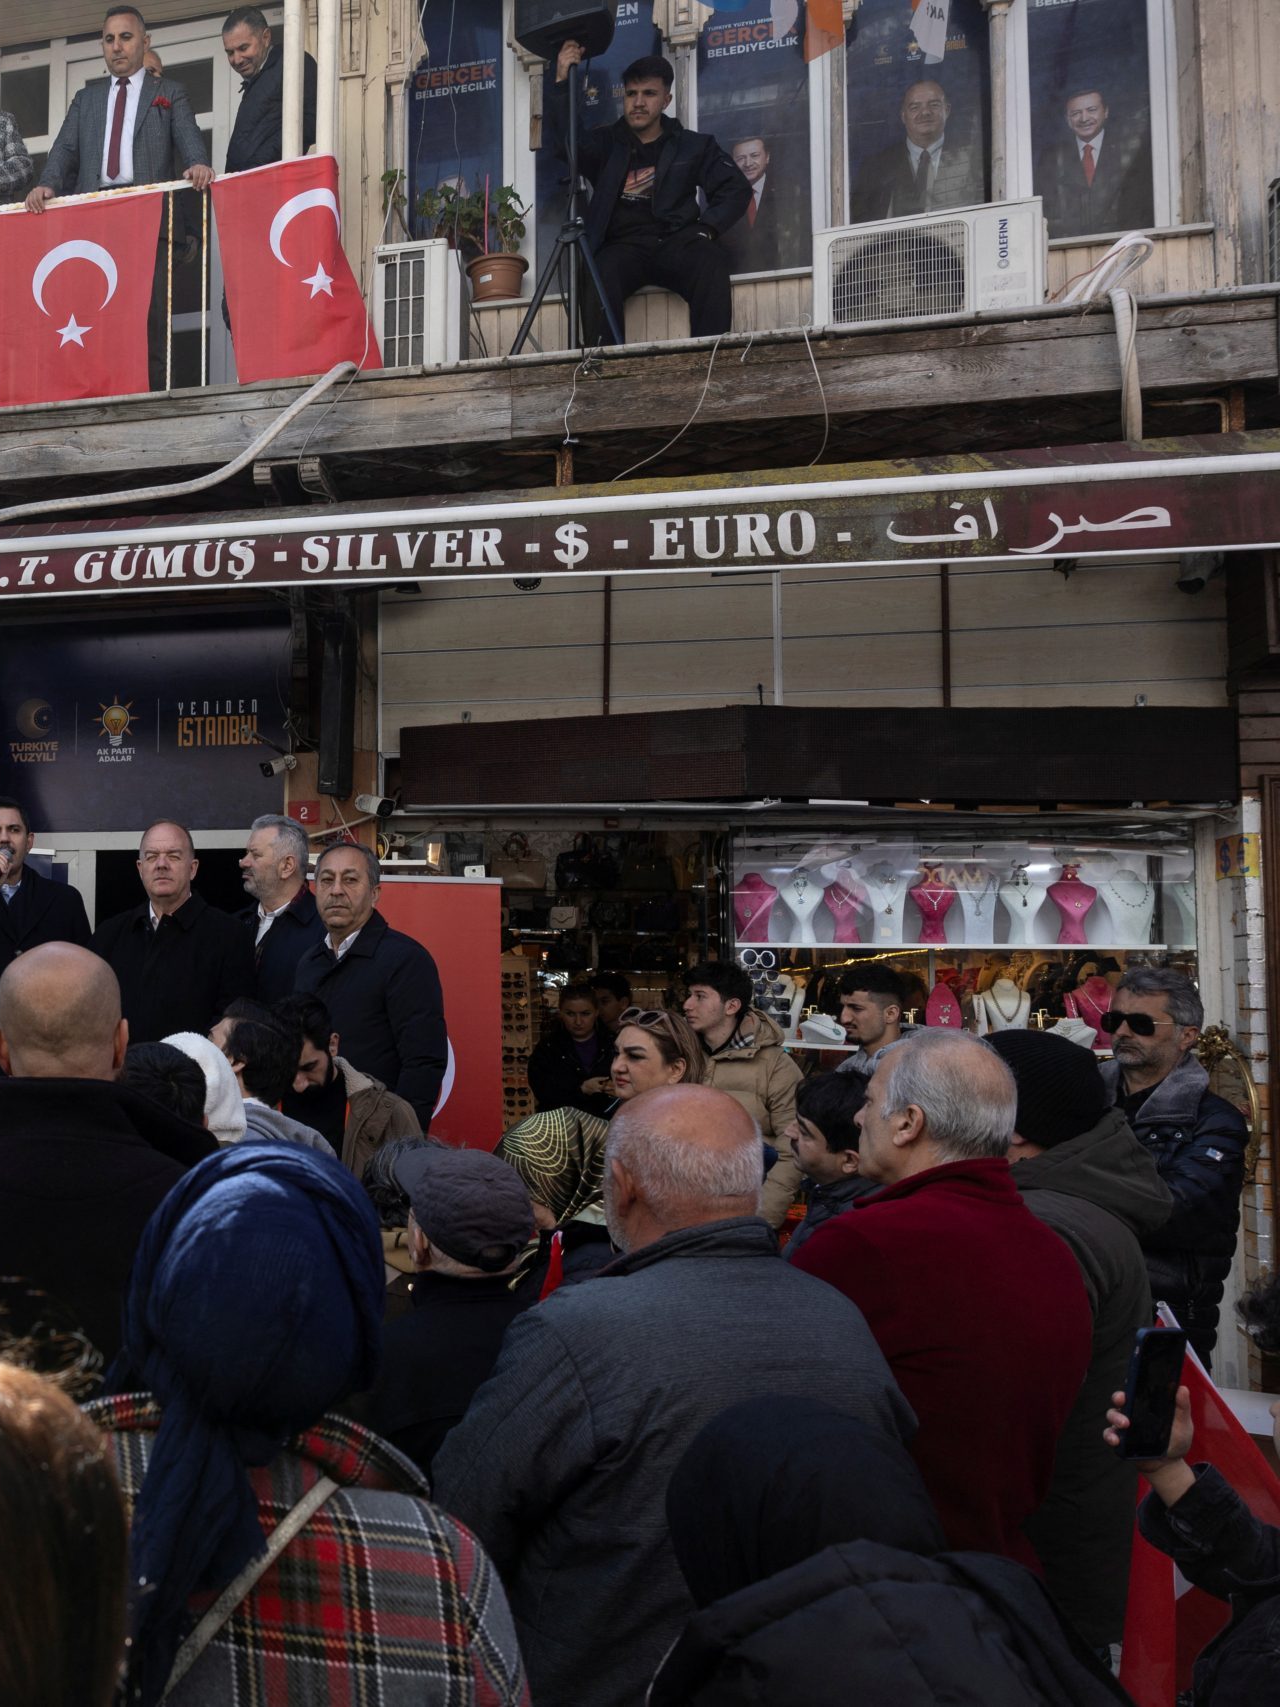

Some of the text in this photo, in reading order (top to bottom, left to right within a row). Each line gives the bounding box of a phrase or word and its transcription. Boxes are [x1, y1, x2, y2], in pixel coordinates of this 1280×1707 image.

[415, 63, 497, 89] GERÇEK
[73, 538, 257, 582] GÜMÜŞ
[301, 527, 504, 574] SILVER
[553, 521, 590, 570] $
[649, 509, 817, 561] EURO
[96, 748, 109, 756] AK
[98, 755, 133, 763] ADALAR
[300, 806, 309, 819] 2
